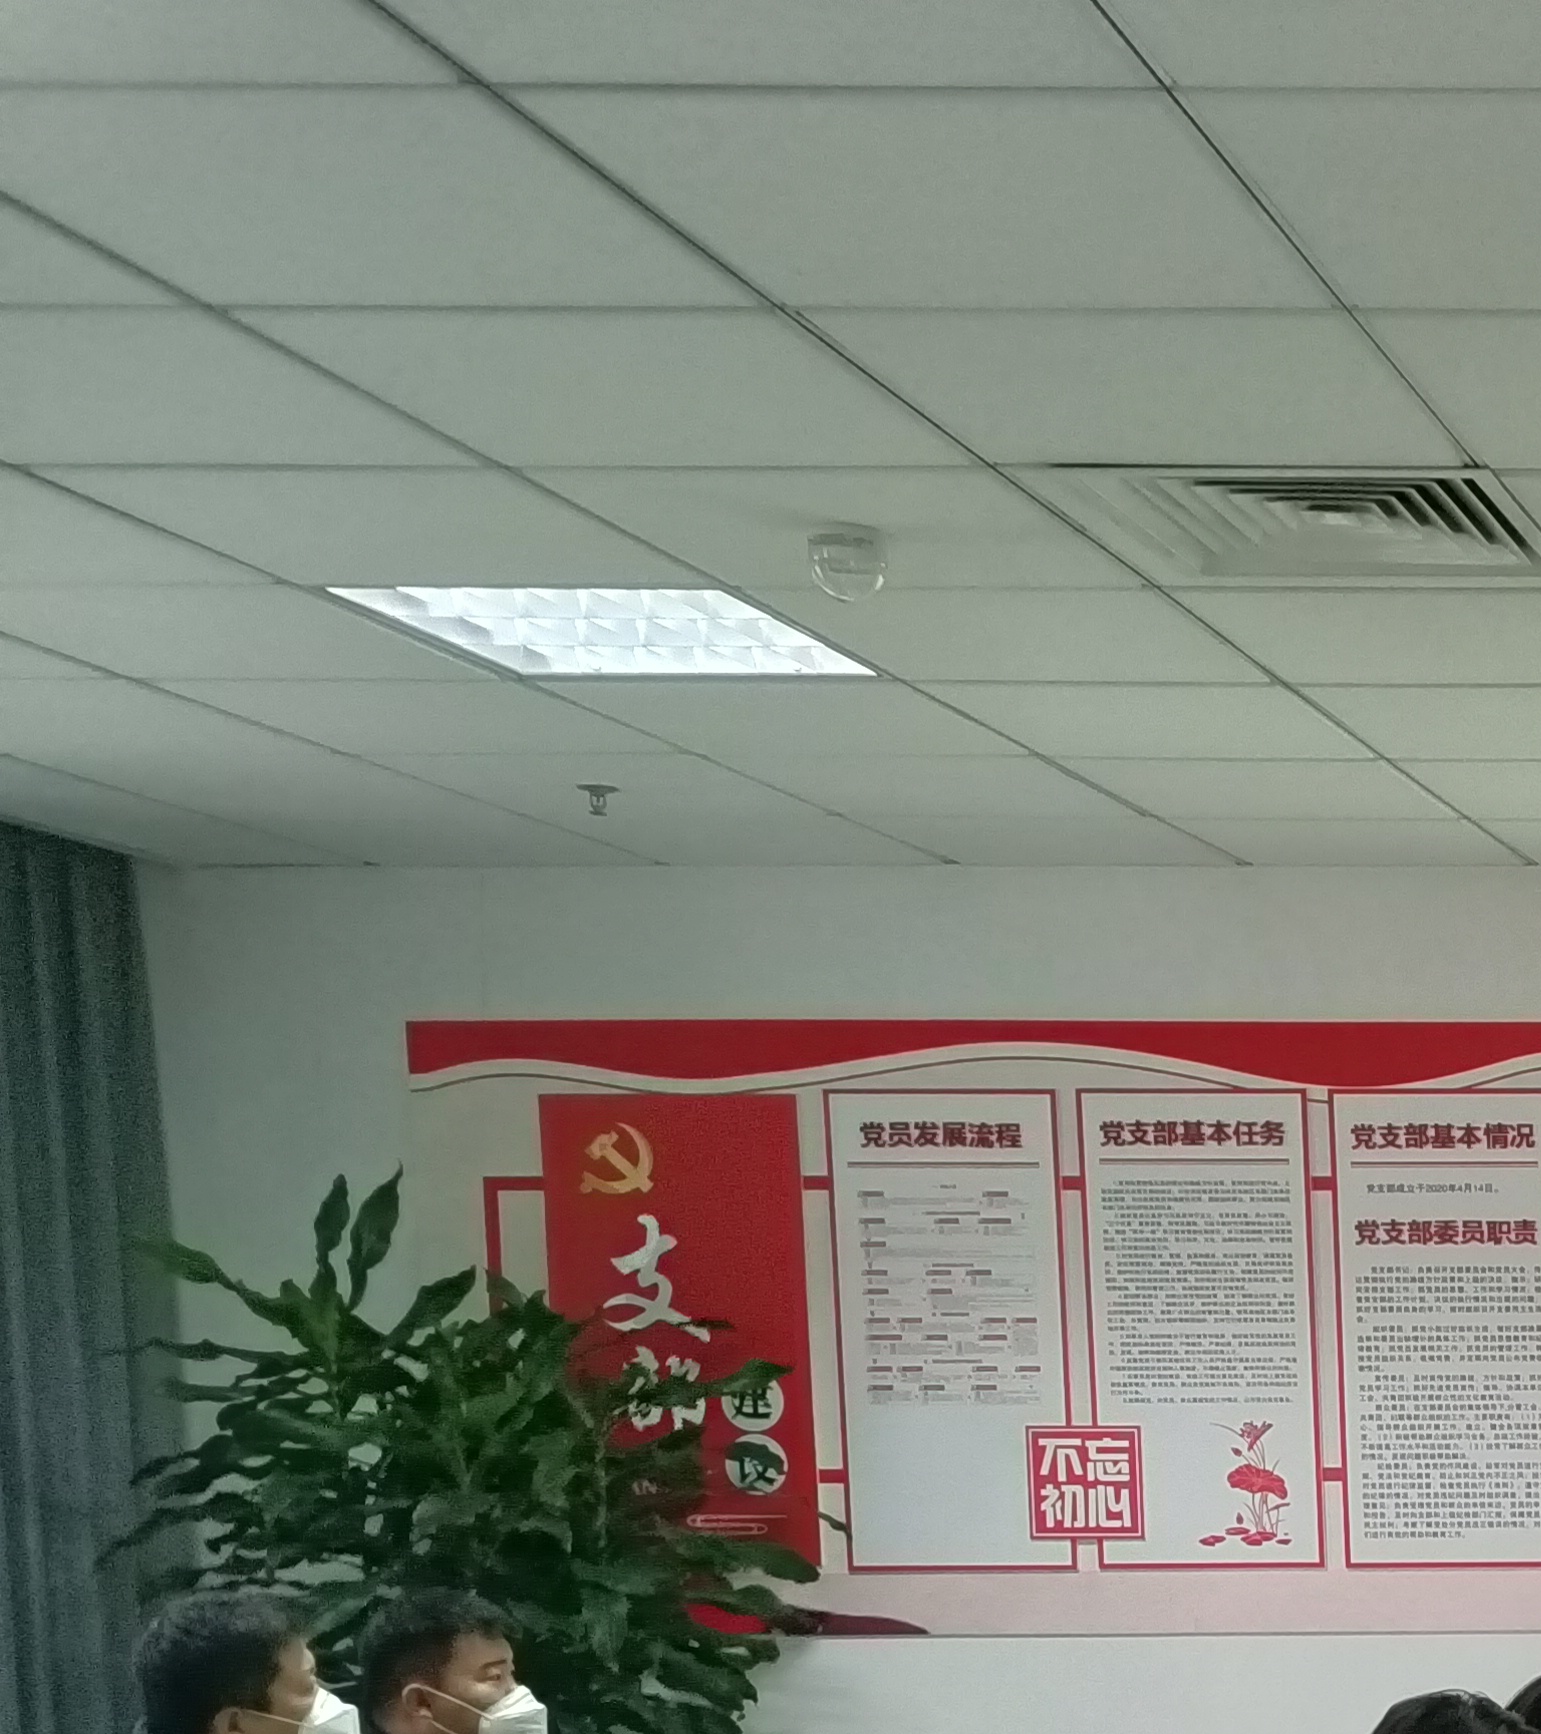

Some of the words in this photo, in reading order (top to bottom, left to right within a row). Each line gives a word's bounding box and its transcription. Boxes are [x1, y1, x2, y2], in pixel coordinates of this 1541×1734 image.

[859, 1121, 1023, 1149] 党员发展流程
[1099, 1119, 1286, 1148] 党支部基本任务
[1351, 1122, 1536, 1150] 党支部基本情况
[1354, 1218, 1538, 1246] 党支部委员职责
[1038, 1438, 1131, 1481] 不忘
[1039, 1483, 1132, 1529] 初心
